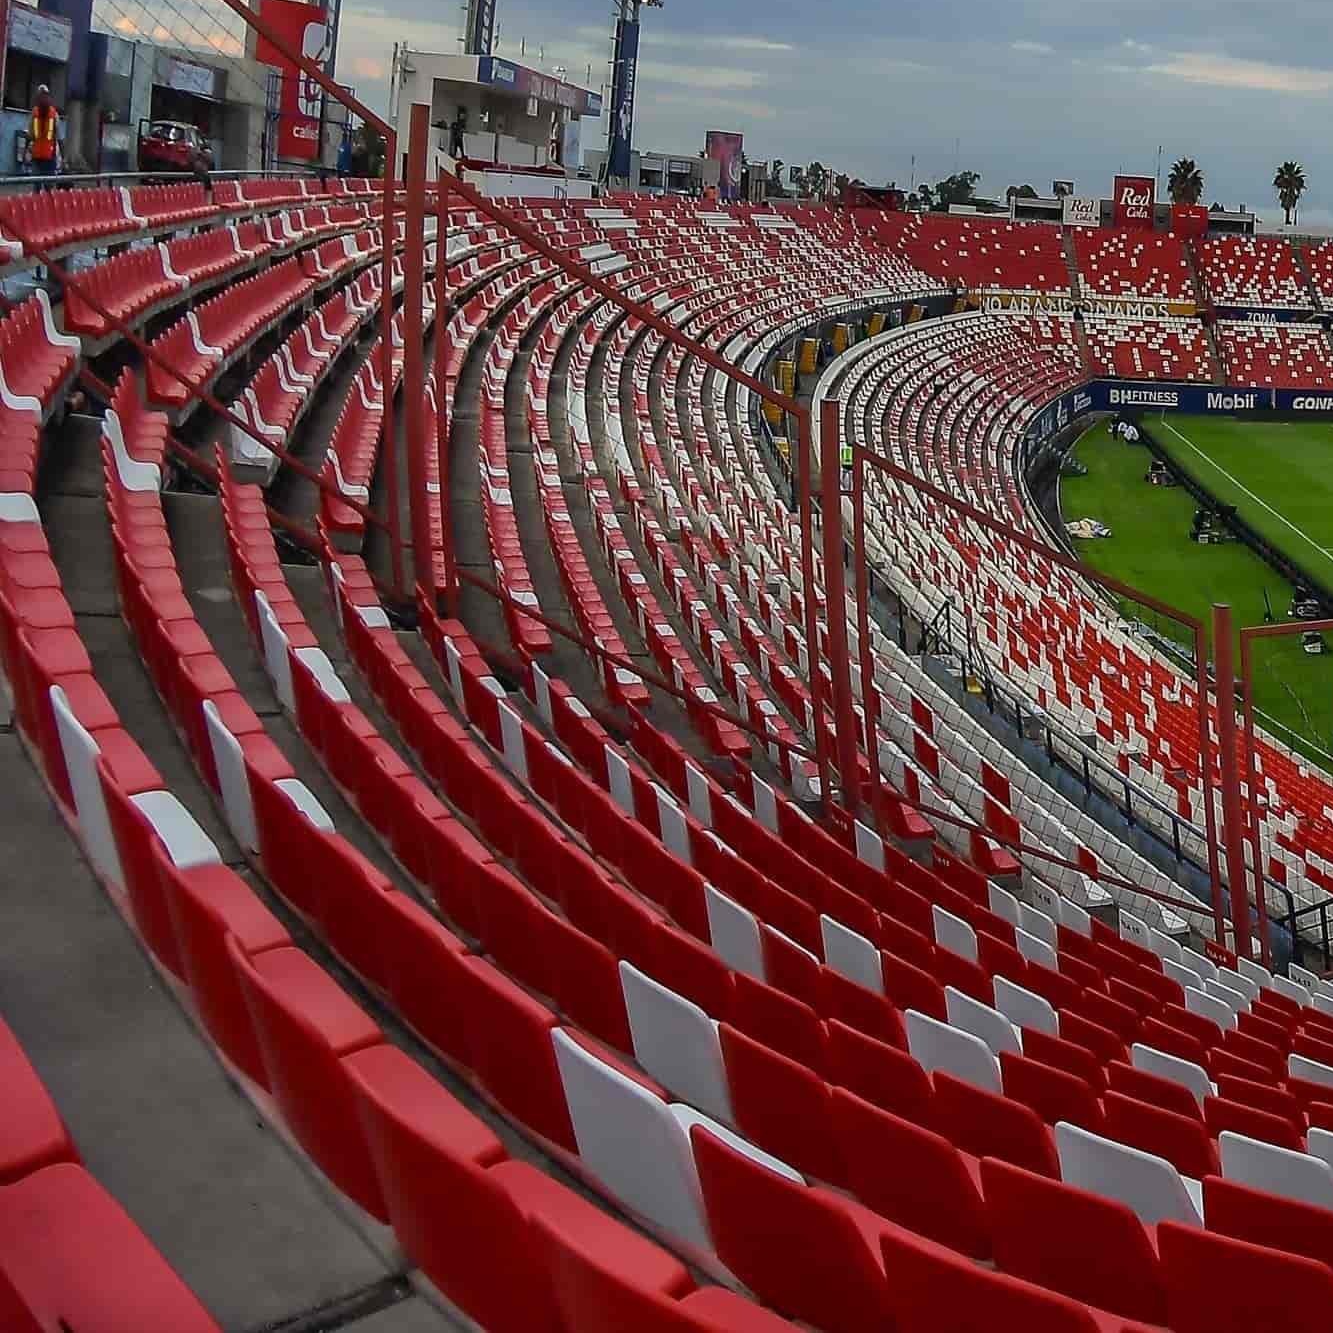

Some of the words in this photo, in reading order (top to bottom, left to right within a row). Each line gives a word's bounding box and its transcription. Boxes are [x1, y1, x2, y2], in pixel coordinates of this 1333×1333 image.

[1120, 187, 1150, 206] Red
[1071, 199, 1094, 213] Red
[1207, 393, 1254, 409] Mobil
